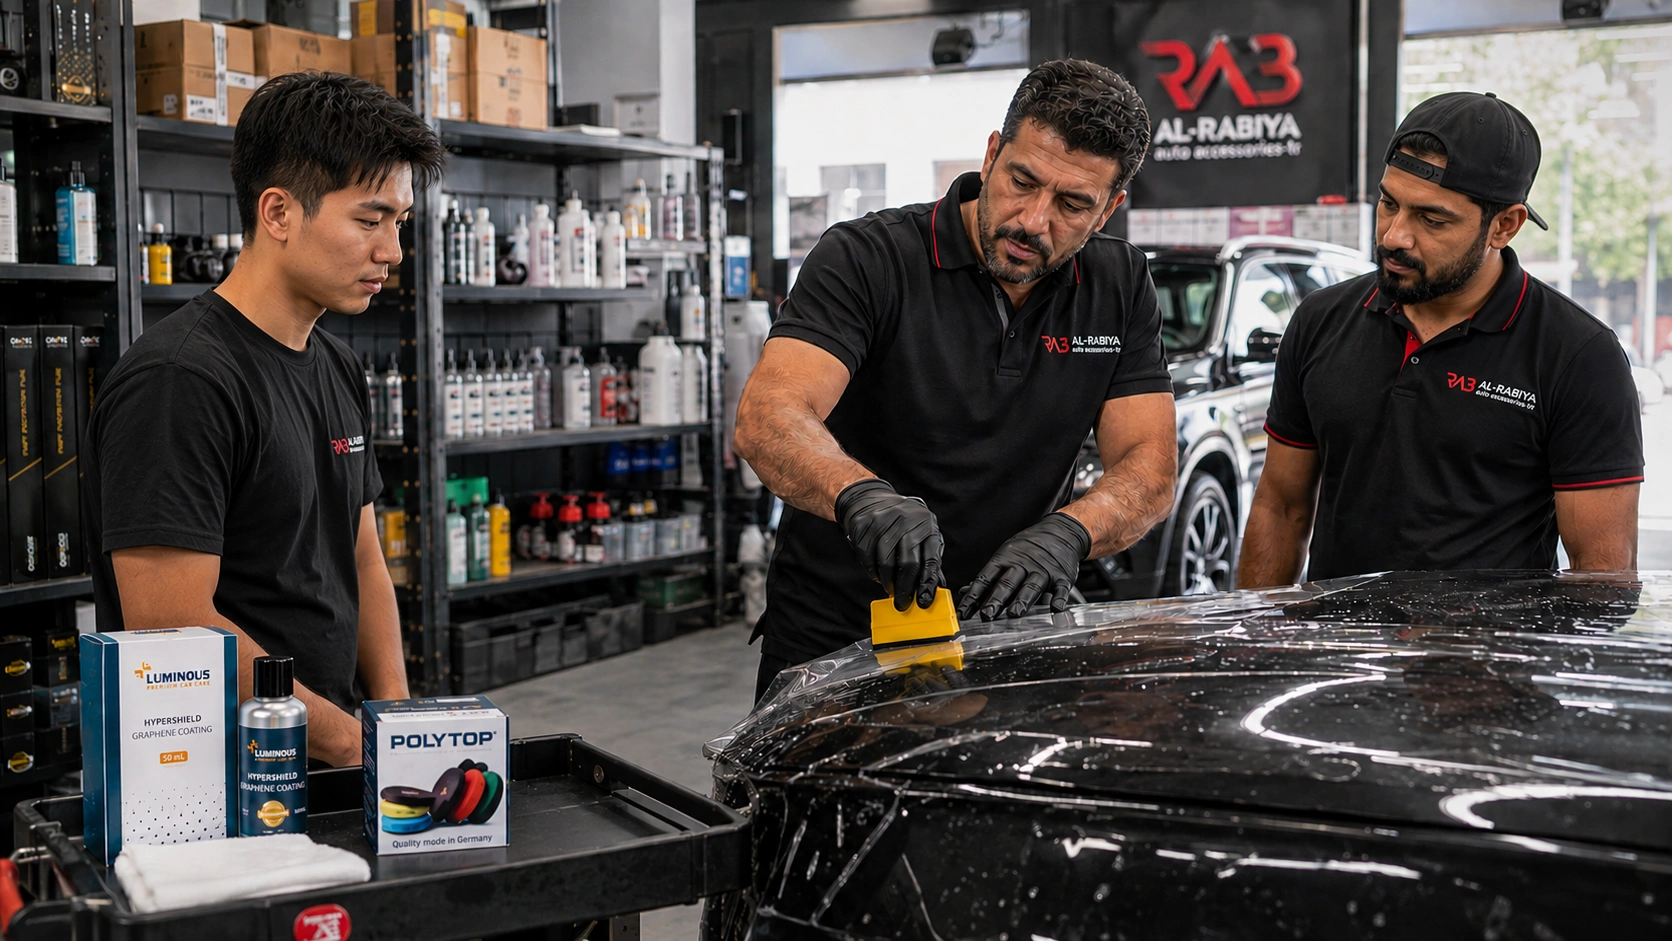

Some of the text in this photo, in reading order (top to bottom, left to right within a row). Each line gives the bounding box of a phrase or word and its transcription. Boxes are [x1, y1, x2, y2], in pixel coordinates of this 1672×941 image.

[1153, 113, 1302, 144] AL-RABIYA
[1154, 145, 1191, 161] auto
[1072, 336, 1121, 345] AL-RABIYA
[1478, 380, 1536, 404] AL-RABIYA
[146, 669, 211, 683] LUMINOUS
[144, 714, 202, 727] HYPERSHIELD
[131, 725, 213, 740] GRAPHENE COATING
[162, 753, 172, 762] 50
[254, 748, 297, 758] LUMINOUS
[247, 772, 298, 782] HYPERSHIELD
[240, 781, 306, 793] GRAPHENE COATING
[392, 839, 422, 849] Quality
[447, 836, 455, 844] in
[456, 834, 493, 845] Germany
